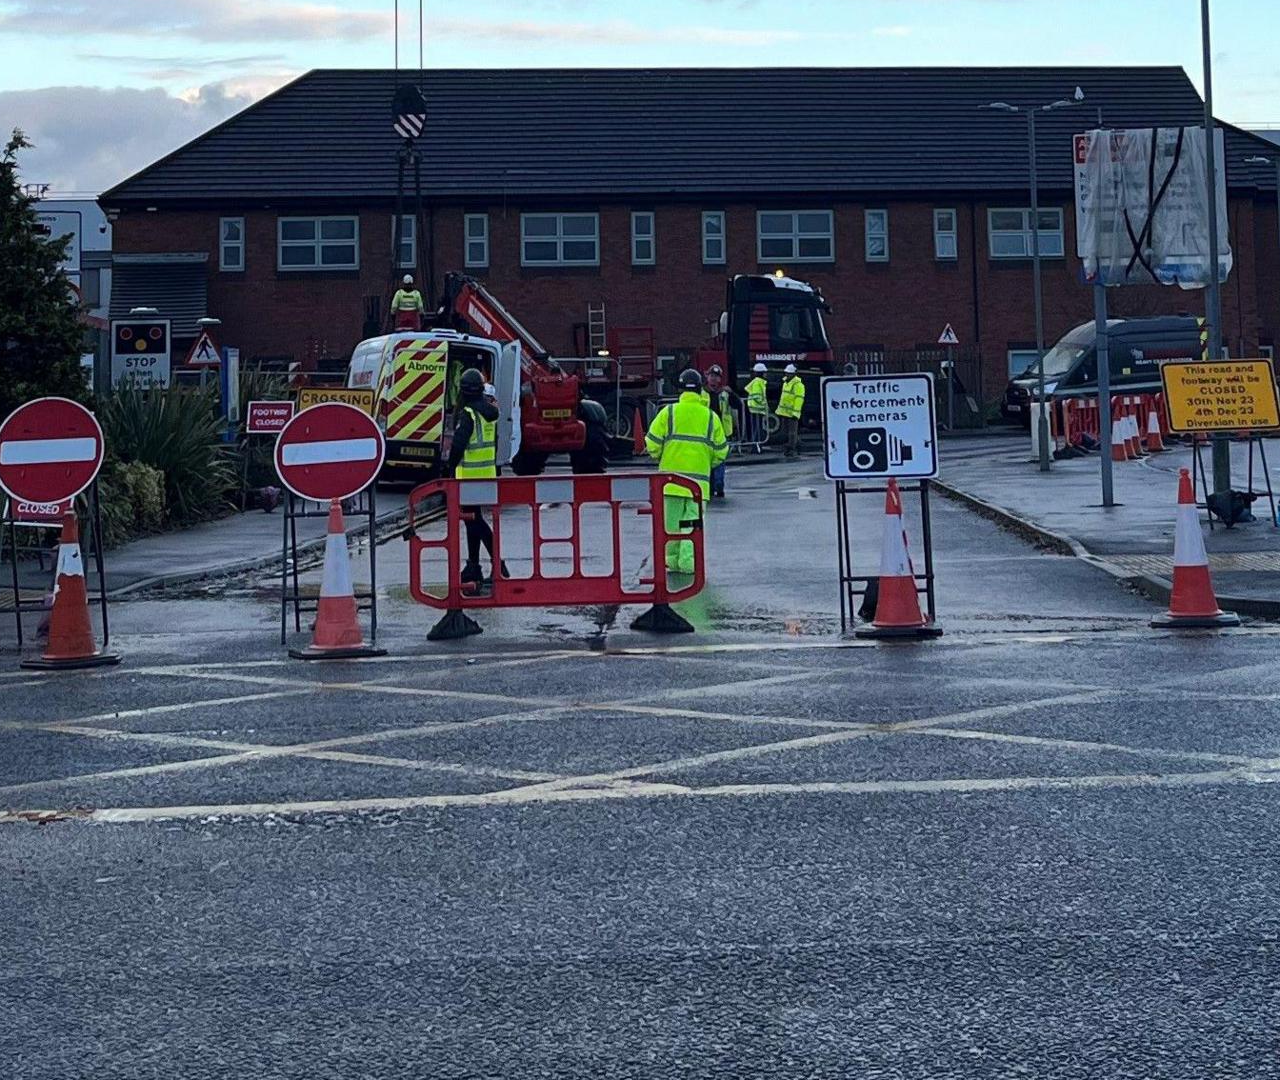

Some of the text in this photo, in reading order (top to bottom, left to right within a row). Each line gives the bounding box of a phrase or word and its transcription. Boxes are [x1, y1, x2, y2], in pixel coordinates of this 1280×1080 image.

[125, 357, 157, 368] STOP
[1184, 364, 1254, 374] This road and
[1181, 375, 1260, 386] footway will be
[853, 382, 900, 394] Traffic
[1200, 385, 1246, 395] CLOSED
[301, 392, 371, 405] CROSSING
[831, 395, 924, 410] enforcement
[1216, 397, 1237, 405] Nov
[1240, 396, 1254, 404] 23
[252, 408, 289, 416] FOOTWAY
[848, 412, 908, 423] cameras
[1195, 408, 1214, 417] 4th
[1217, 408, 1237, 416] Dec
[1186, 419, 1235, 428] Diversion
[1237, 418, 1247, 426] in
[17, 503, 60, 515] CLOSED
